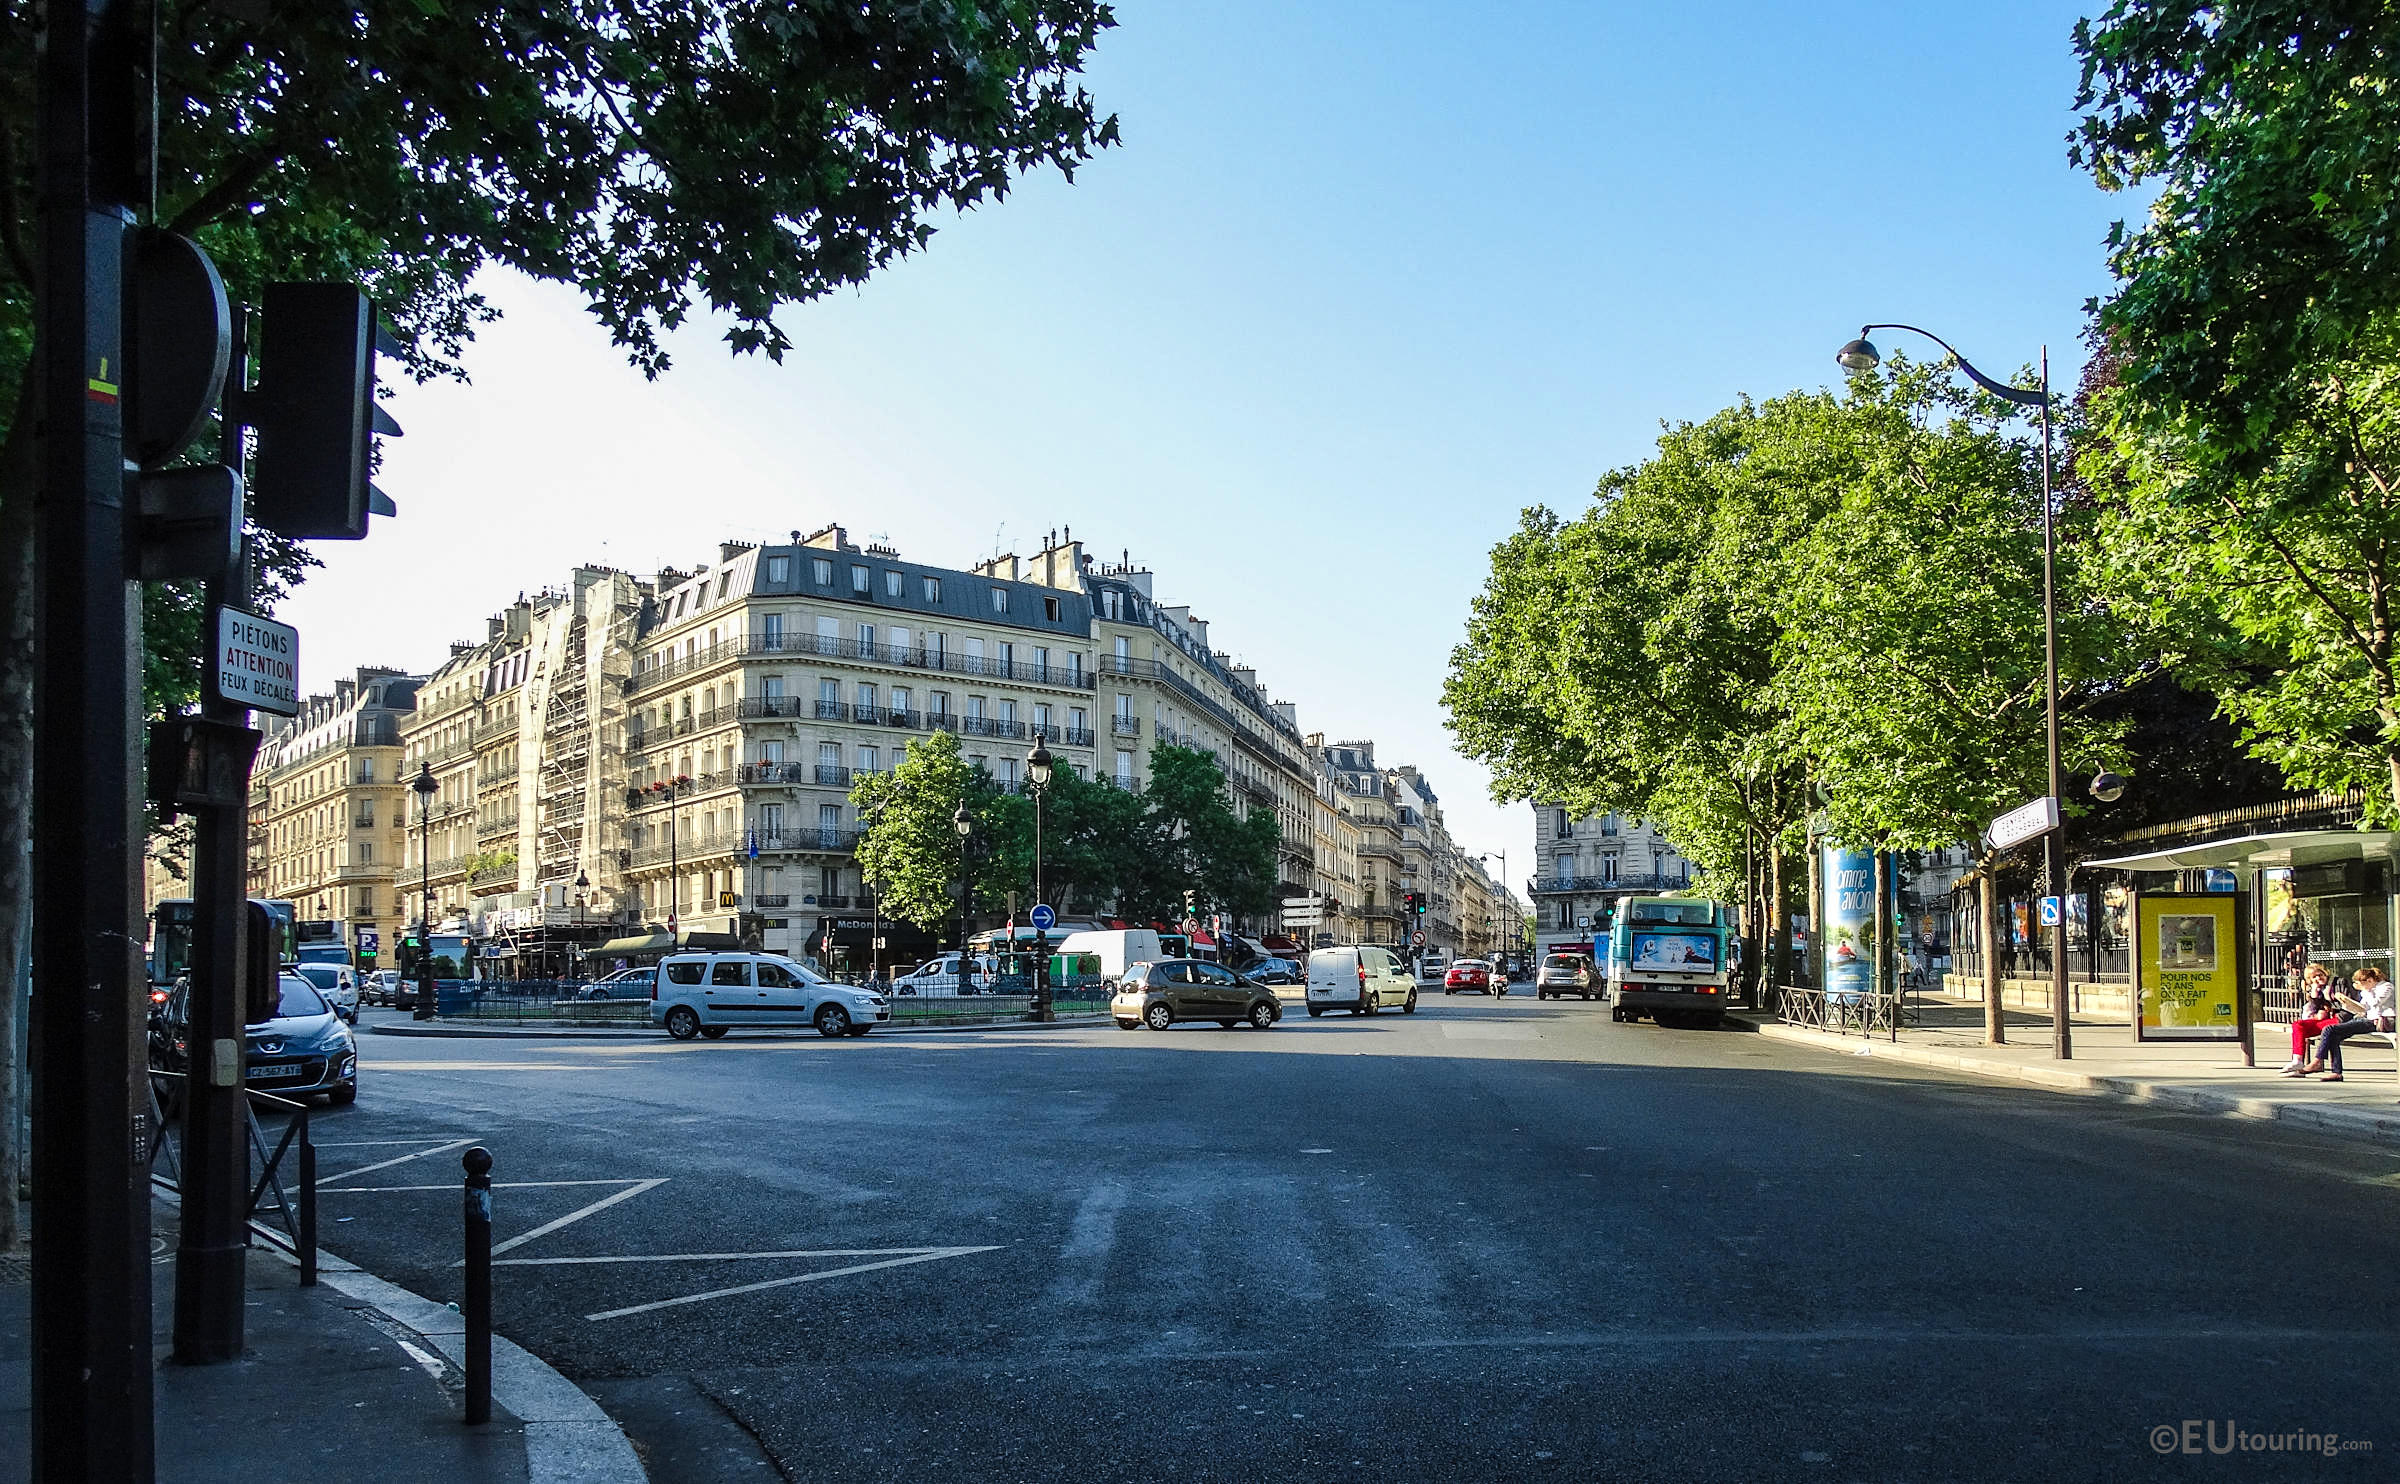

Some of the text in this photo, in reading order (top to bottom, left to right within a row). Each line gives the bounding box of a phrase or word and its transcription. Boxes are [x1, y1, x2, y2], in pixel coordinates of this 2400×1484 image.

[233, 621, 287, 654] PIÉTONS
[227, 647, 293, 681] ATTENTION
[221, 671, 296, 703] FEUX DÉCALÉS
[1836, 869, 1868, 889] omme
[1841, 888, 1873, 911] avion
[837, 919, 896, 929] McDonld's
[2160, 973, 2212, 982] POUR NOS
[2174, 981, 2194, 990] ANS
[2187, 990, 2208, 999] FAIT
